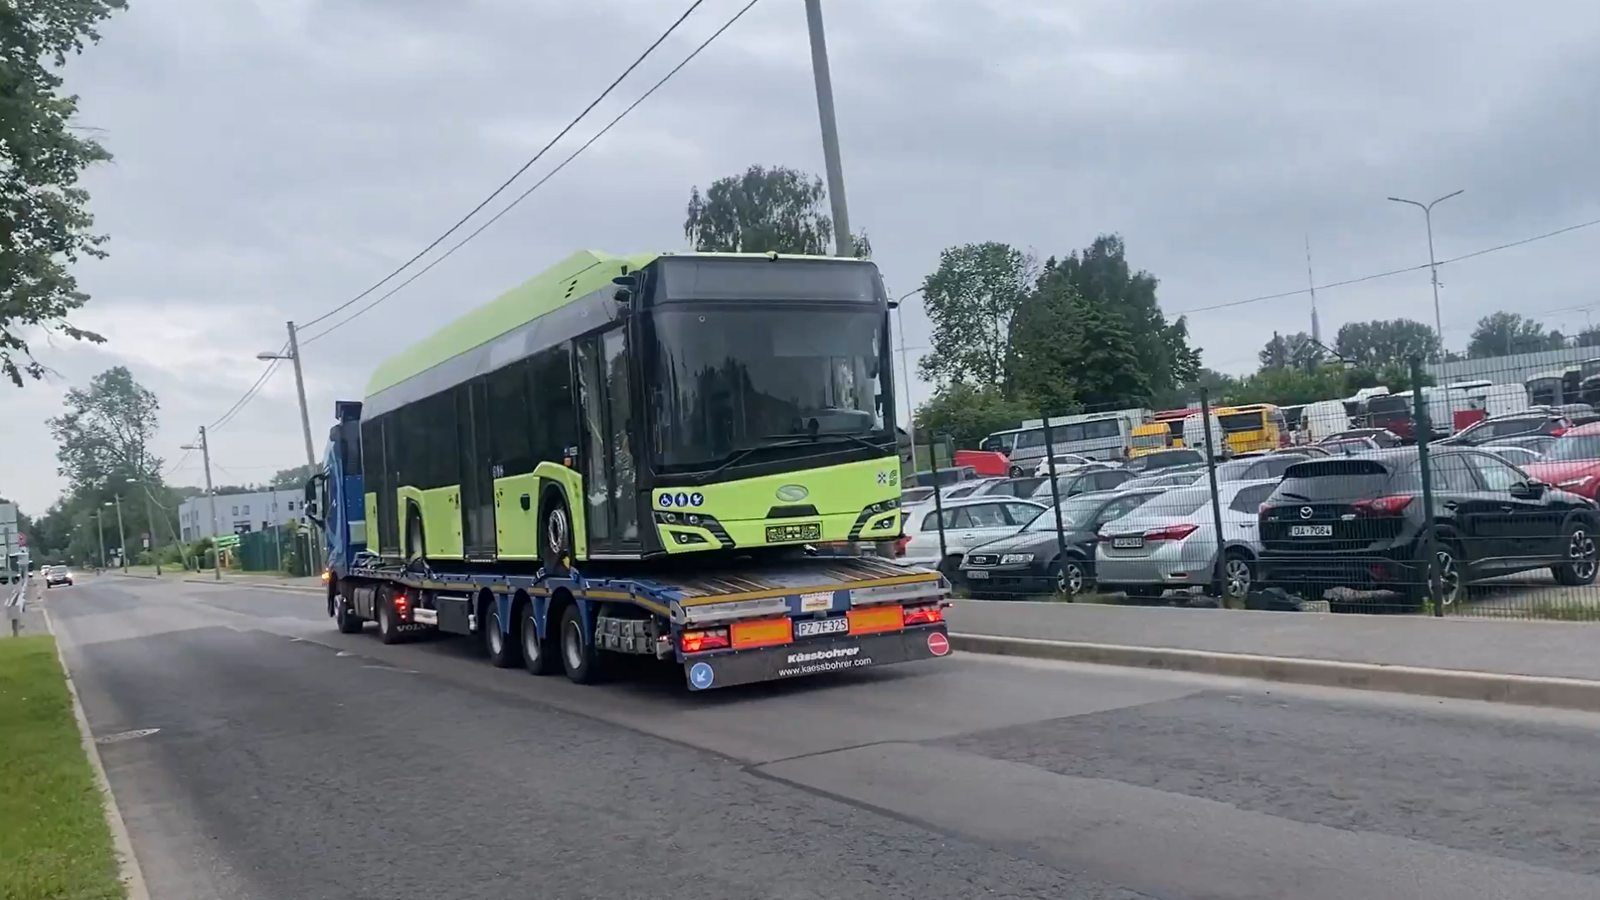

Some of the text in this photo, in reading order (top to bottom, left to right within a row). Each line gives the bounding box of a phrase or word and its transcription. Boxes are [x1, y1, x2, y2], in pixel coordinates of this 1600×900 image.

[396, 623, 434, 632] VOLV
[800, 623, 814, 635] PZ
[778, 657, 872, 676] www.kaessbohrer.com
